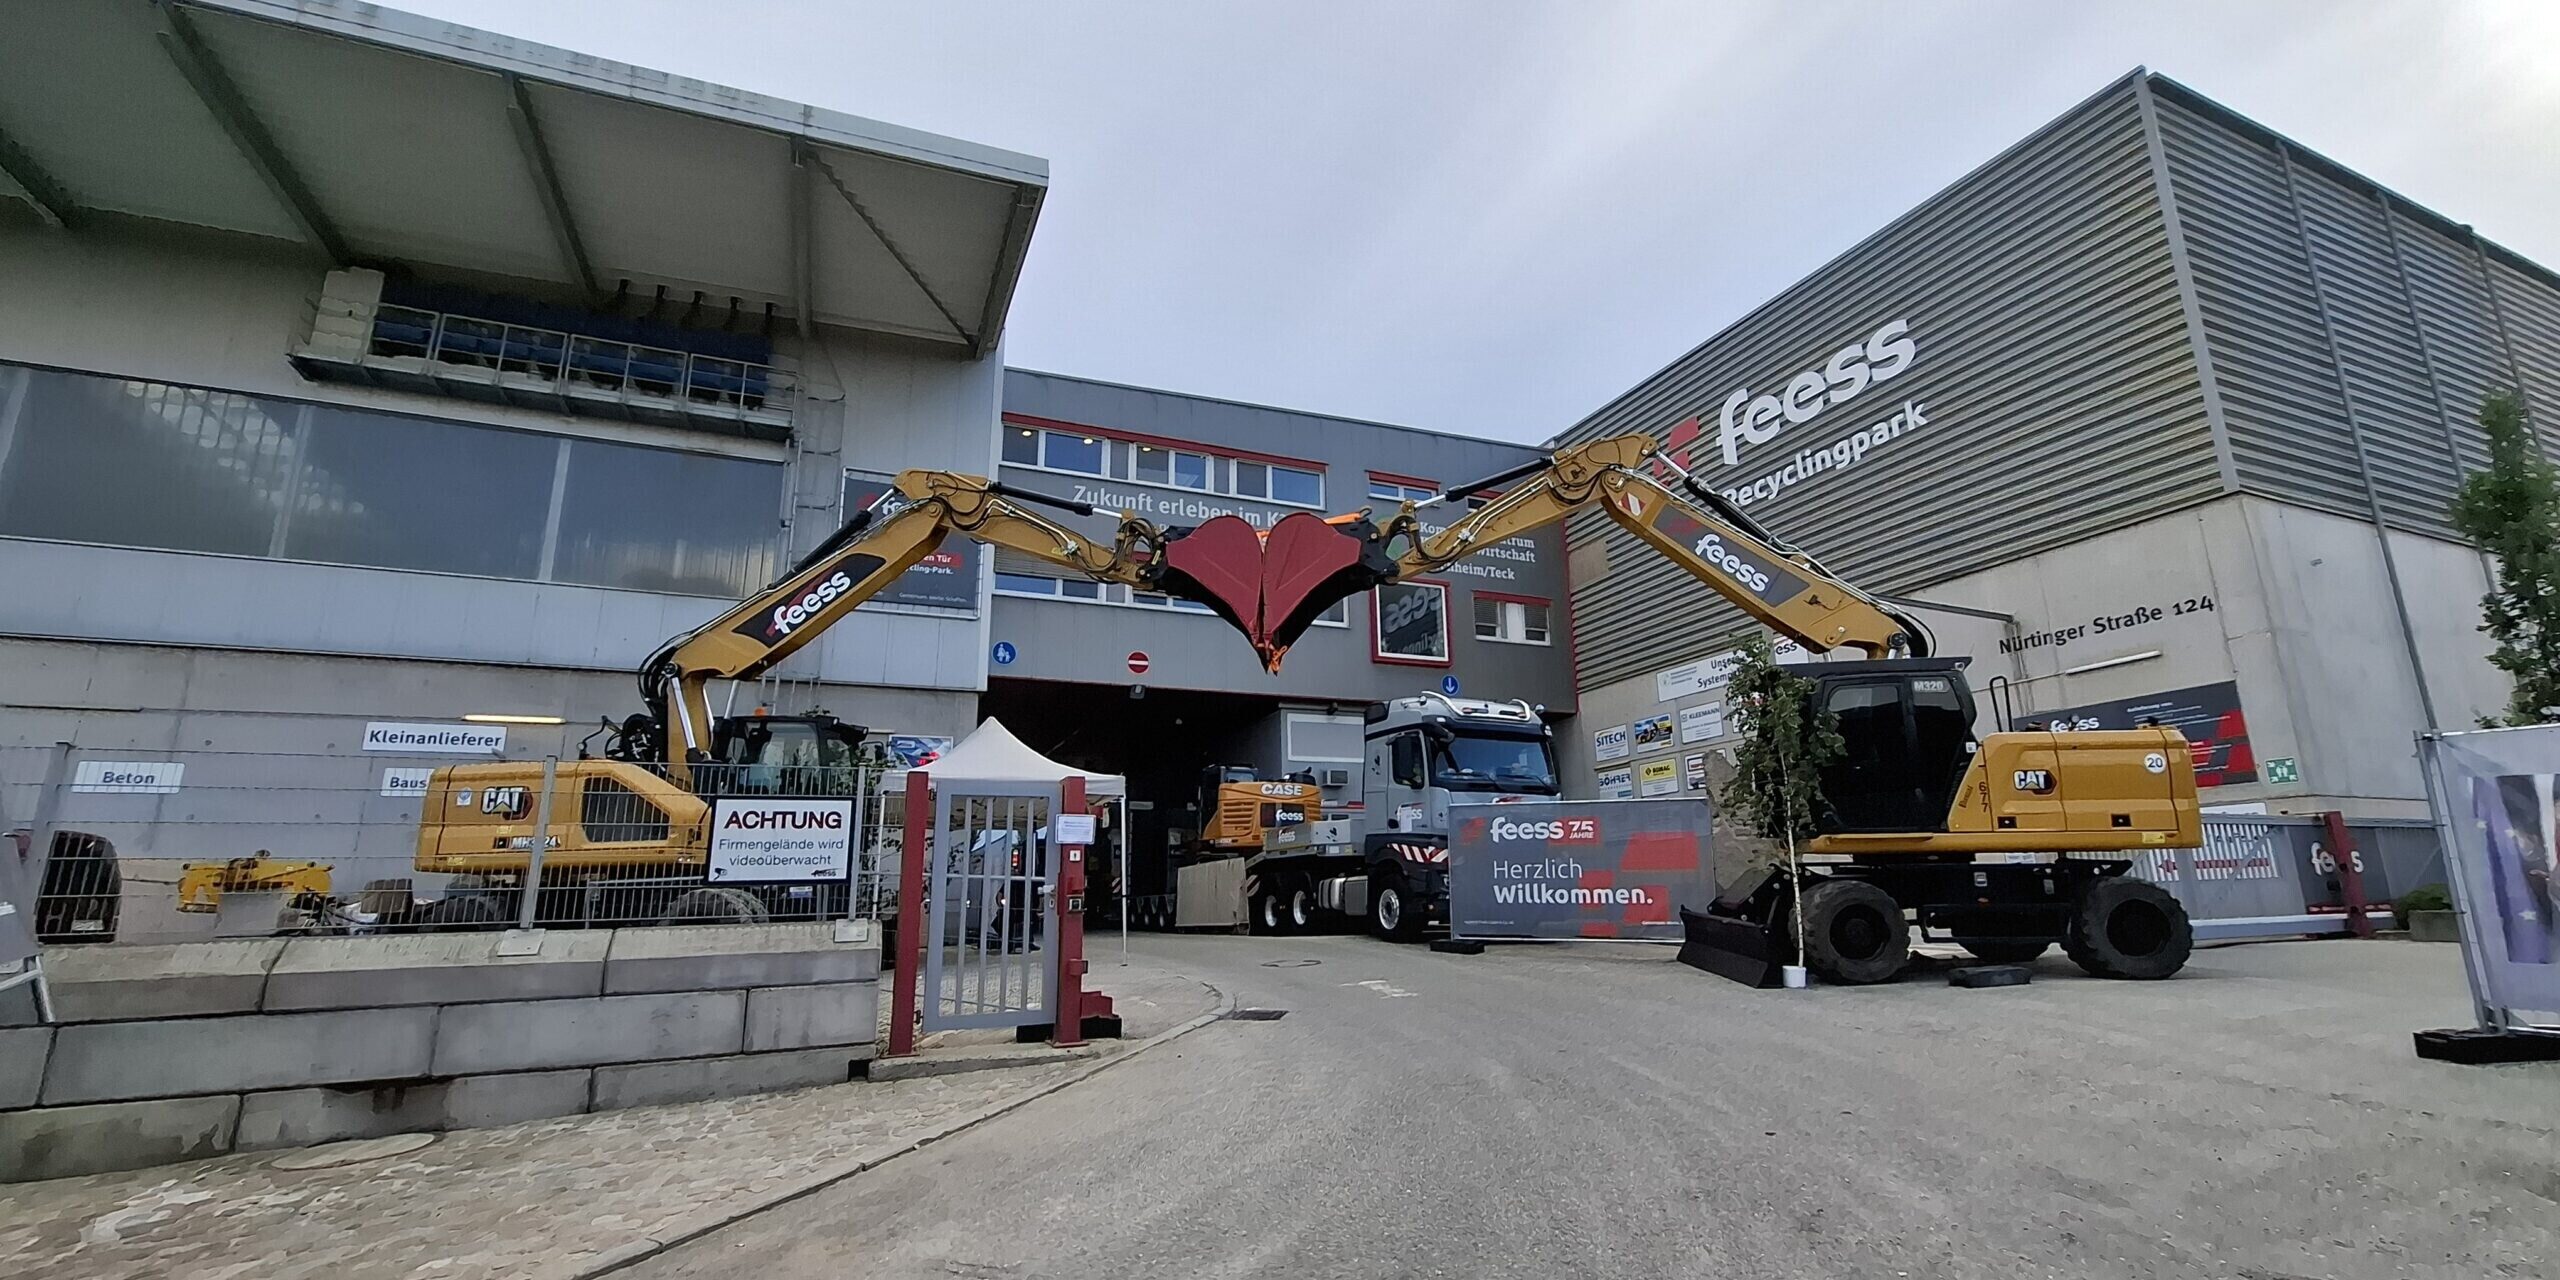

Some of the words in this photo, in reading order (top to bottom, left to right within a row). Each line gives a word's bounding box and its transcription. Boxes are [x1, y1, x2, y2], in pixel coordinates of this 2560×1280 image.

[1716, 319, 1917, 465] feess
[1072, 485, 1152, 512] Zukunft
[1159, 498, 1232, 519] erleben
[937, 554, 952, 563] Tür
[1695, 534, 1769, 592] feess
[774, 571, 851, 634] feess
[1999, 623, 2086, 655] Nürtinger
[2093, 606, 2162, 635] Straße
[2172, 595, 2214, 616] 124
[1914, 680, 1943, 693] M320
[369, 730, 502, 747] Kleinanlieferer
[1596, 731, 1626, 747] SITECH
[2147, 757, 2163, 768] 20
[102, 771, 155, 784] Beton
[389, 777, 427, 788] Baus
[2013, 770, 2048, 790] CAT
[1260, 784, 1303, 796] CASE
[482, 786, 523, 813] CAT
[723, 810, 842, 829] ACHTUNG
[1275, 808, 1304, 822] feess
[1490, 816, 1564, 843] feess
[1568, 820, 1594, 831] 75
[719, 838, 814, 852] Firmengelände
[819, 839, 844, 849] wird
[729, 854, 832, 866] videoüberwacht
[1493, 858, 1583, 879] Herzlich
[1493, 883, 1653, 904] Willkommen.
